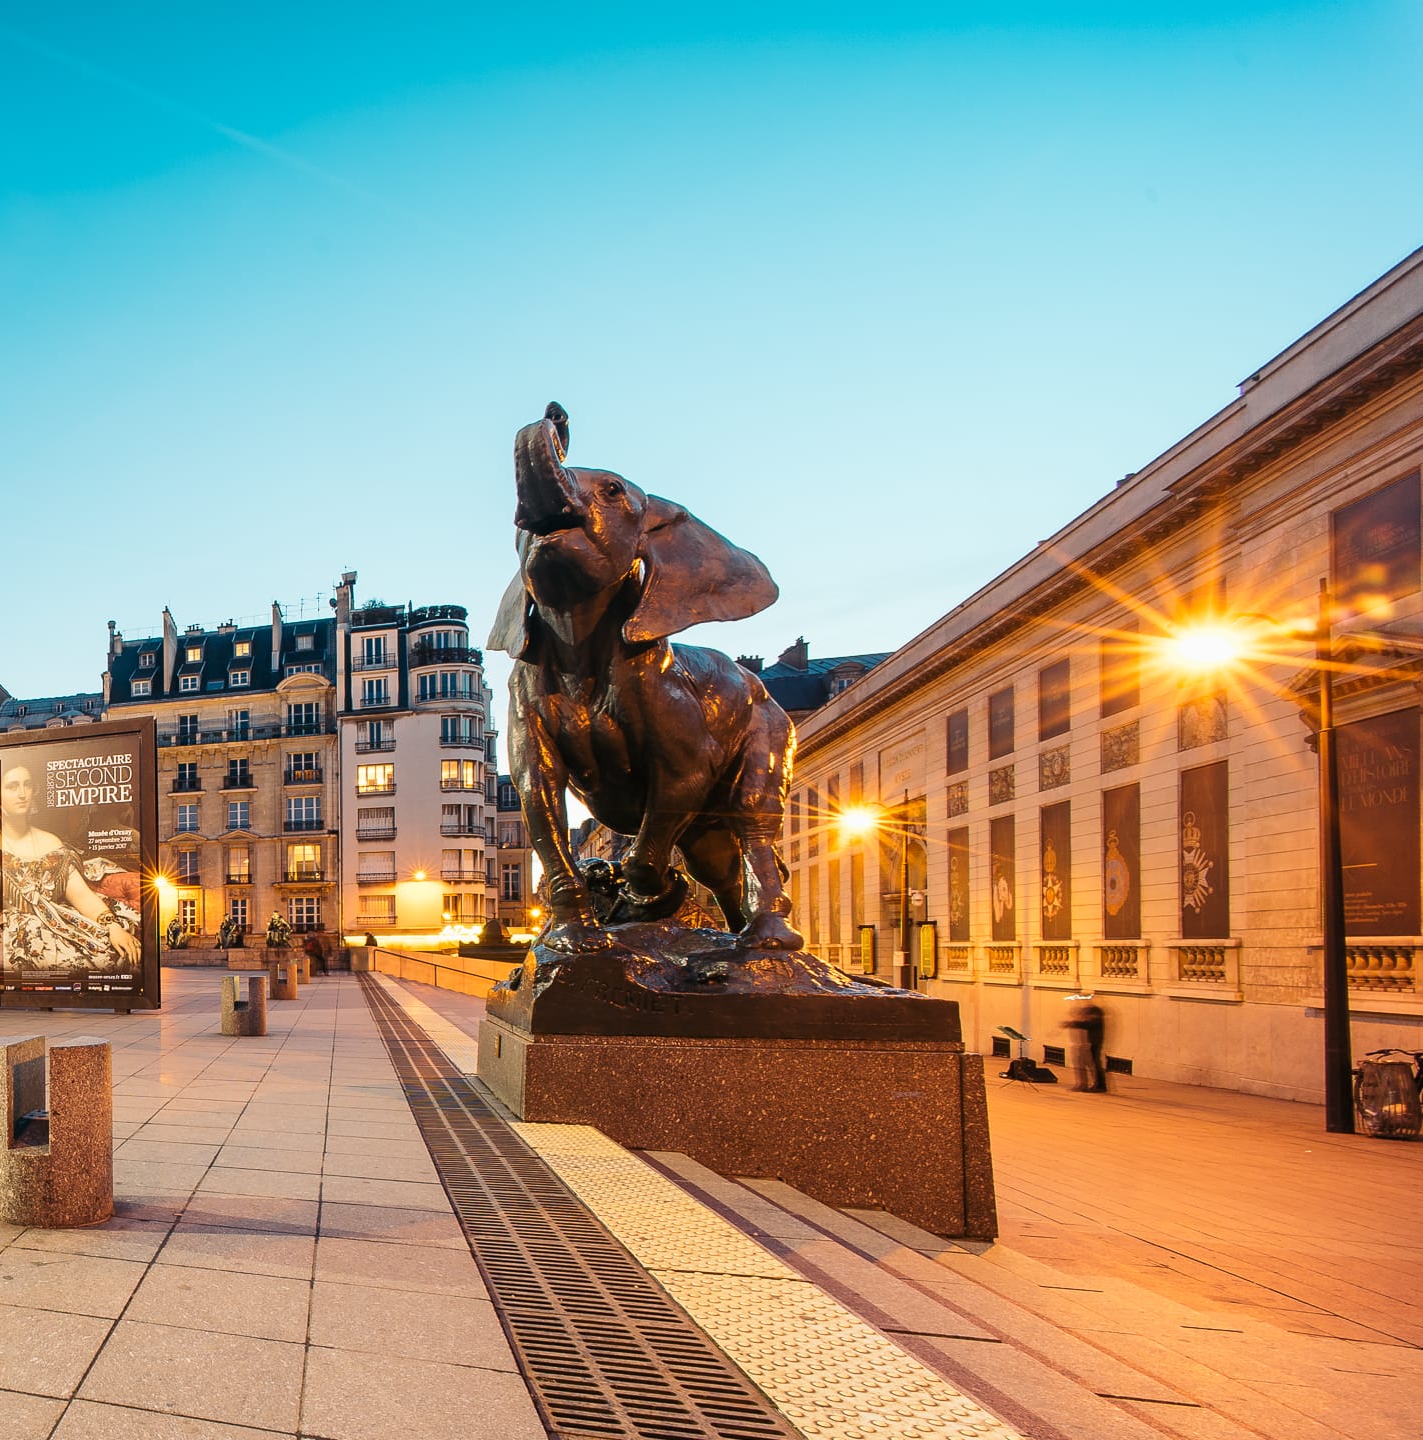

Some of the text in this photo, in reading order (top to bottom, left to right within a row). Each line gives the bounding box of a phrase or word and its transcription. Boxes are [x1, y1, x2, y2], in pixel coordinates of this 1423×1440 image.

[47, 754, 132, 771] SPECTACULAIRE
[55, 765, 133, 789] SECOND
[47, 771, 55, 807] 1852-1870
[56, 784, 133, 808] EMPIRE
[88, 828, 132, 837] Musée d'Orsay
[95, 836, 120, 844] septembre
[98, 843, 115, 851] janvier
